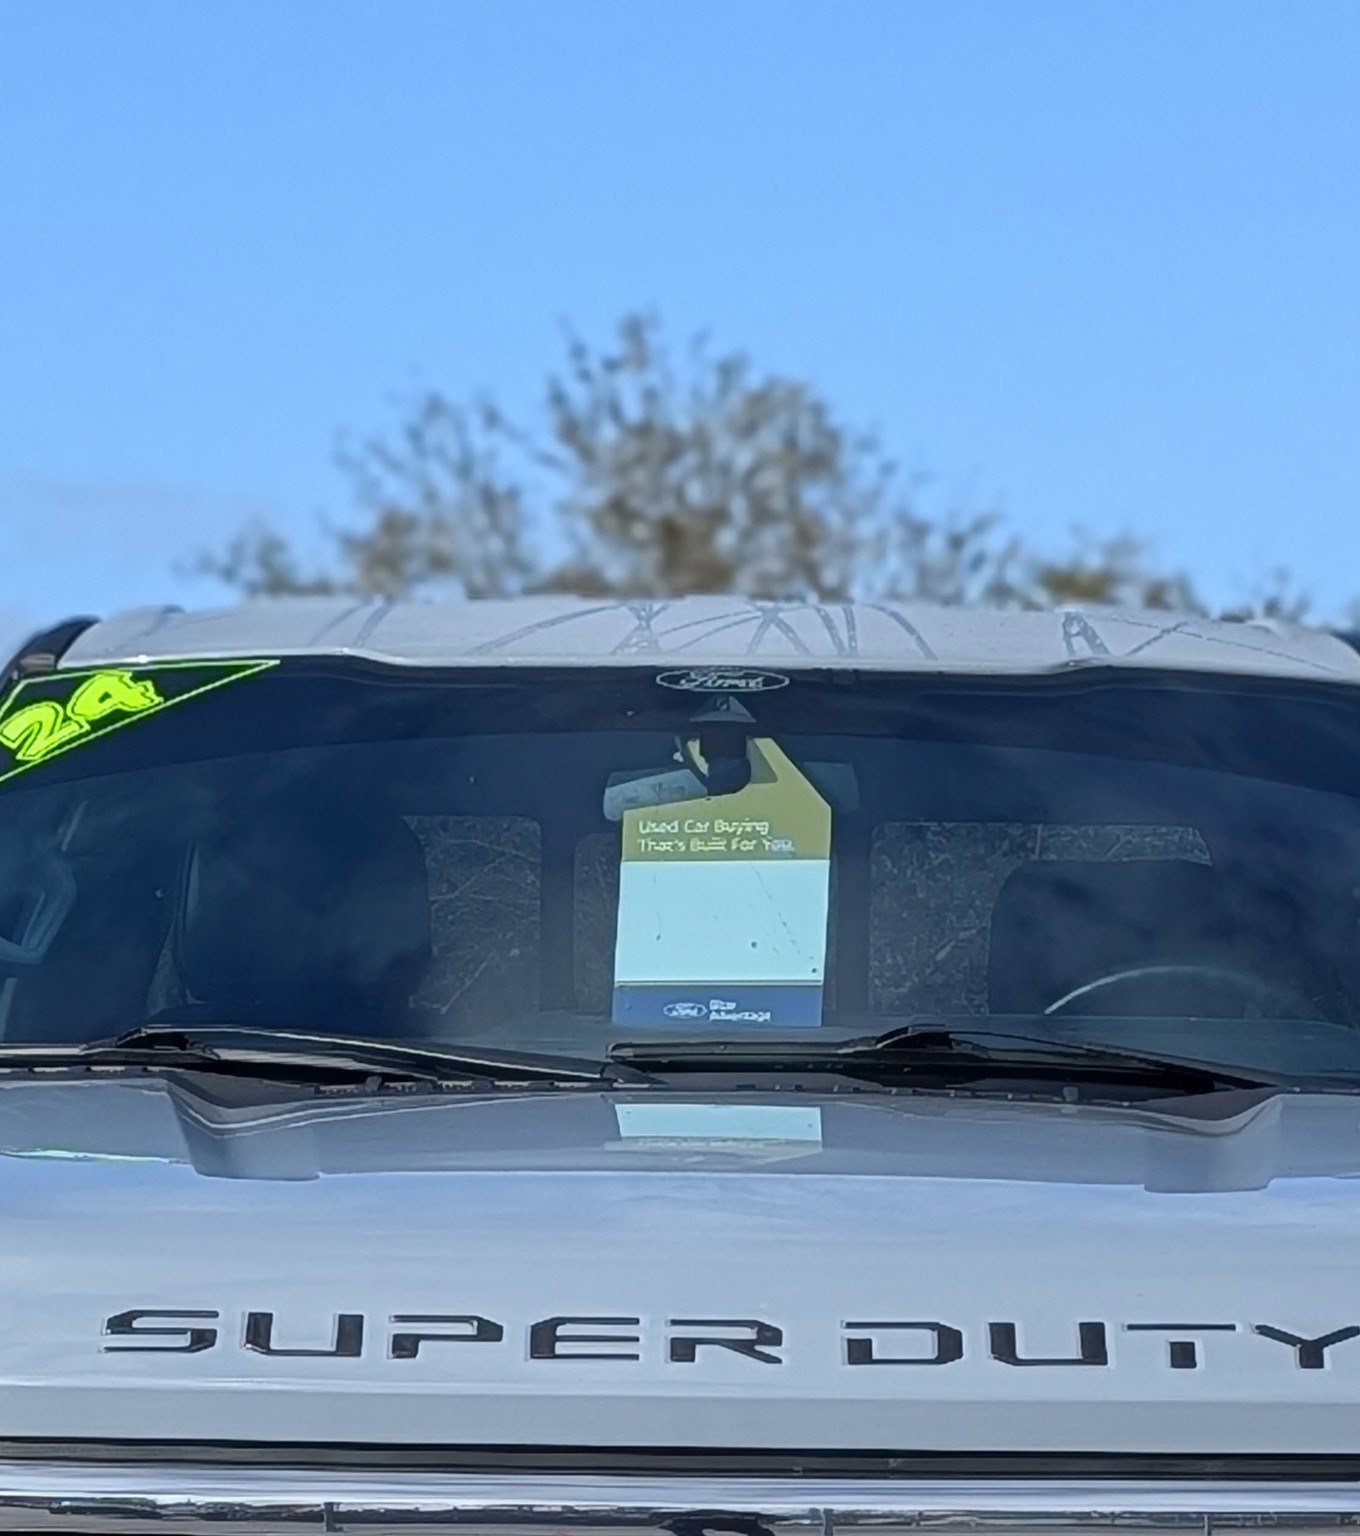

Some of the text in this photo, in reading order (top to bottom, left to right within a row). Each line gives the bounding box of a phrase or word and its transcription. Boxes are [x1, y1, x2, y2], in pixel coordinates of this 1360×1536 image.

[638, 818, 769, 836] Used Car Buying
[637, 838, 686, 852] That's
[690, 836, 727, 852] Built
[731, 837, 757, 852] For
[99, 1309, 783, 1366] SUPER
